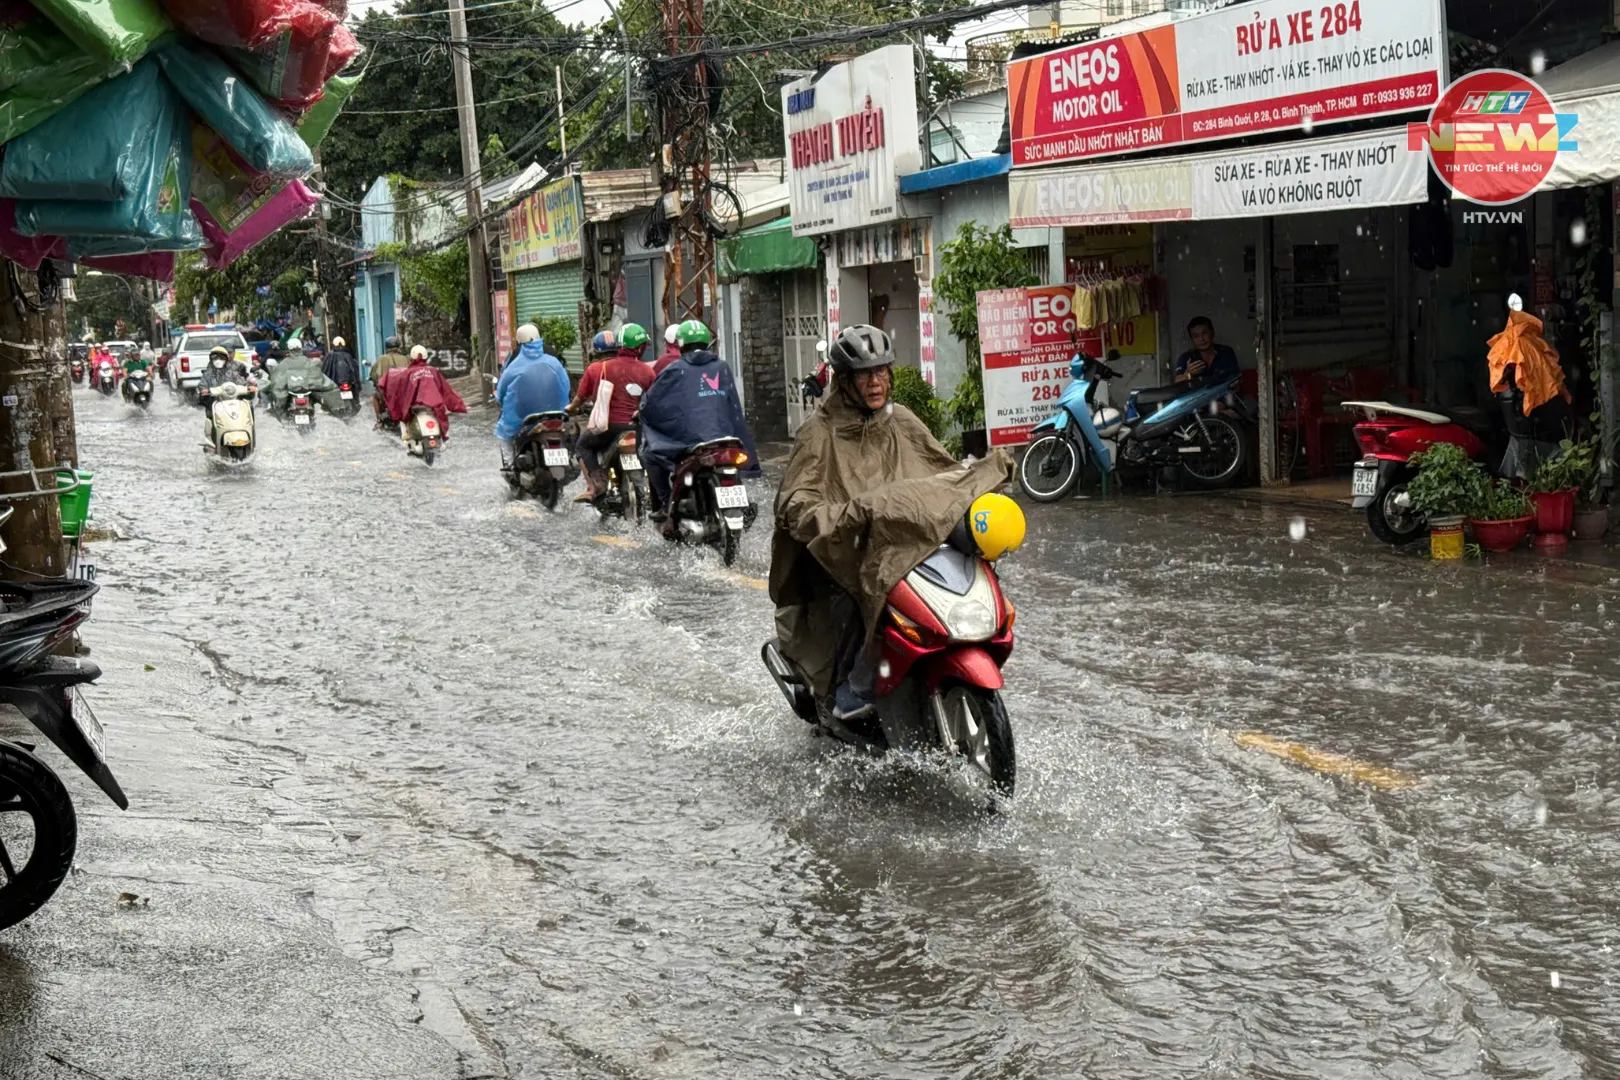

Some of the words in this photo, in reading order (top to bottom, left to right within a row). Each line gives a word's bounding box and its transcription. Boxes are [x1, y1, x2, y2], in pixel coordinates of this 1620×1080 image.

[1236, 11, 1281, 56] RỬA
[1288, 10, 1314, 46] XE
[1320, 0, 1362, 38] 284
[1049, 44, 1121, 94] ENEOS
[1187, 78, 1205, 99] RỬA
[1206, 78, 1218, 93] XE
[1224, 73, 1246, 92] THAY
[1248, 64, 1274, 87] NHỚT
[1282, 60, 1295, 81] VÁ
[1297, 61, 1310, 78] XE
[1318, 54, 1345, 74] THAY
[1346, 45, 1360, 69] VỎ
[1363, 48, 1377, 67] XE
[1380, 40, 1403, 63] CÁC
[1406, 37, 1433, 61] LOẠI
[1052, 94, 1098, 124] MOTOR
[1100, 89, 1123, 115] OIL
[1281, 105, 1299, 118] Bình
[1338, 96, 1357, 109] HCM
[1377, 90, 1398, 104] 0933
[1399, 88, 1415, 101] 936
[1416, 83, 1433, 97] 227
[1024, 142, 1042, 161] SỨC
[1043, 143, 1067, 161] MẠNH
[1068, 133, 1087, 153] DẦU
[1088, 130, 1113, 151] NHỚT
[1114, 127, 1139, 151] NHẬT
[1142, 122, 1163, 144] BẢN
[1214, 161, 1238, 183] SỬA
[1240, 163, 1255, 180] XE
[1265, 154, 1291, 178] RỬA
[1295, 156, 1310, 173] XE
[1321, 151, 1353, 172] THAY
[1357, 141, 1396, 167] NHỚT
[1036, 174, 1105, 211] ENEOS
[1163, 179, 1187, 202] OIL
[1242, 185, 1257, 206] VÁ
[1258, 182, 1275, 204] VỎ
[1278, 177, 1323, 204] KHÔNG
[1326, 175, 1362, 202] RUỘT
[1021, 366, 1050, 383] RỬA
[1053, 367, 1069, 380] XE
[1015, 407, 1024, 415] XE
[1030, 404, 1049, 413] THAY
[1032, 384, 1062, 401] 284
[1010, 416, 1028, 425] THAY
